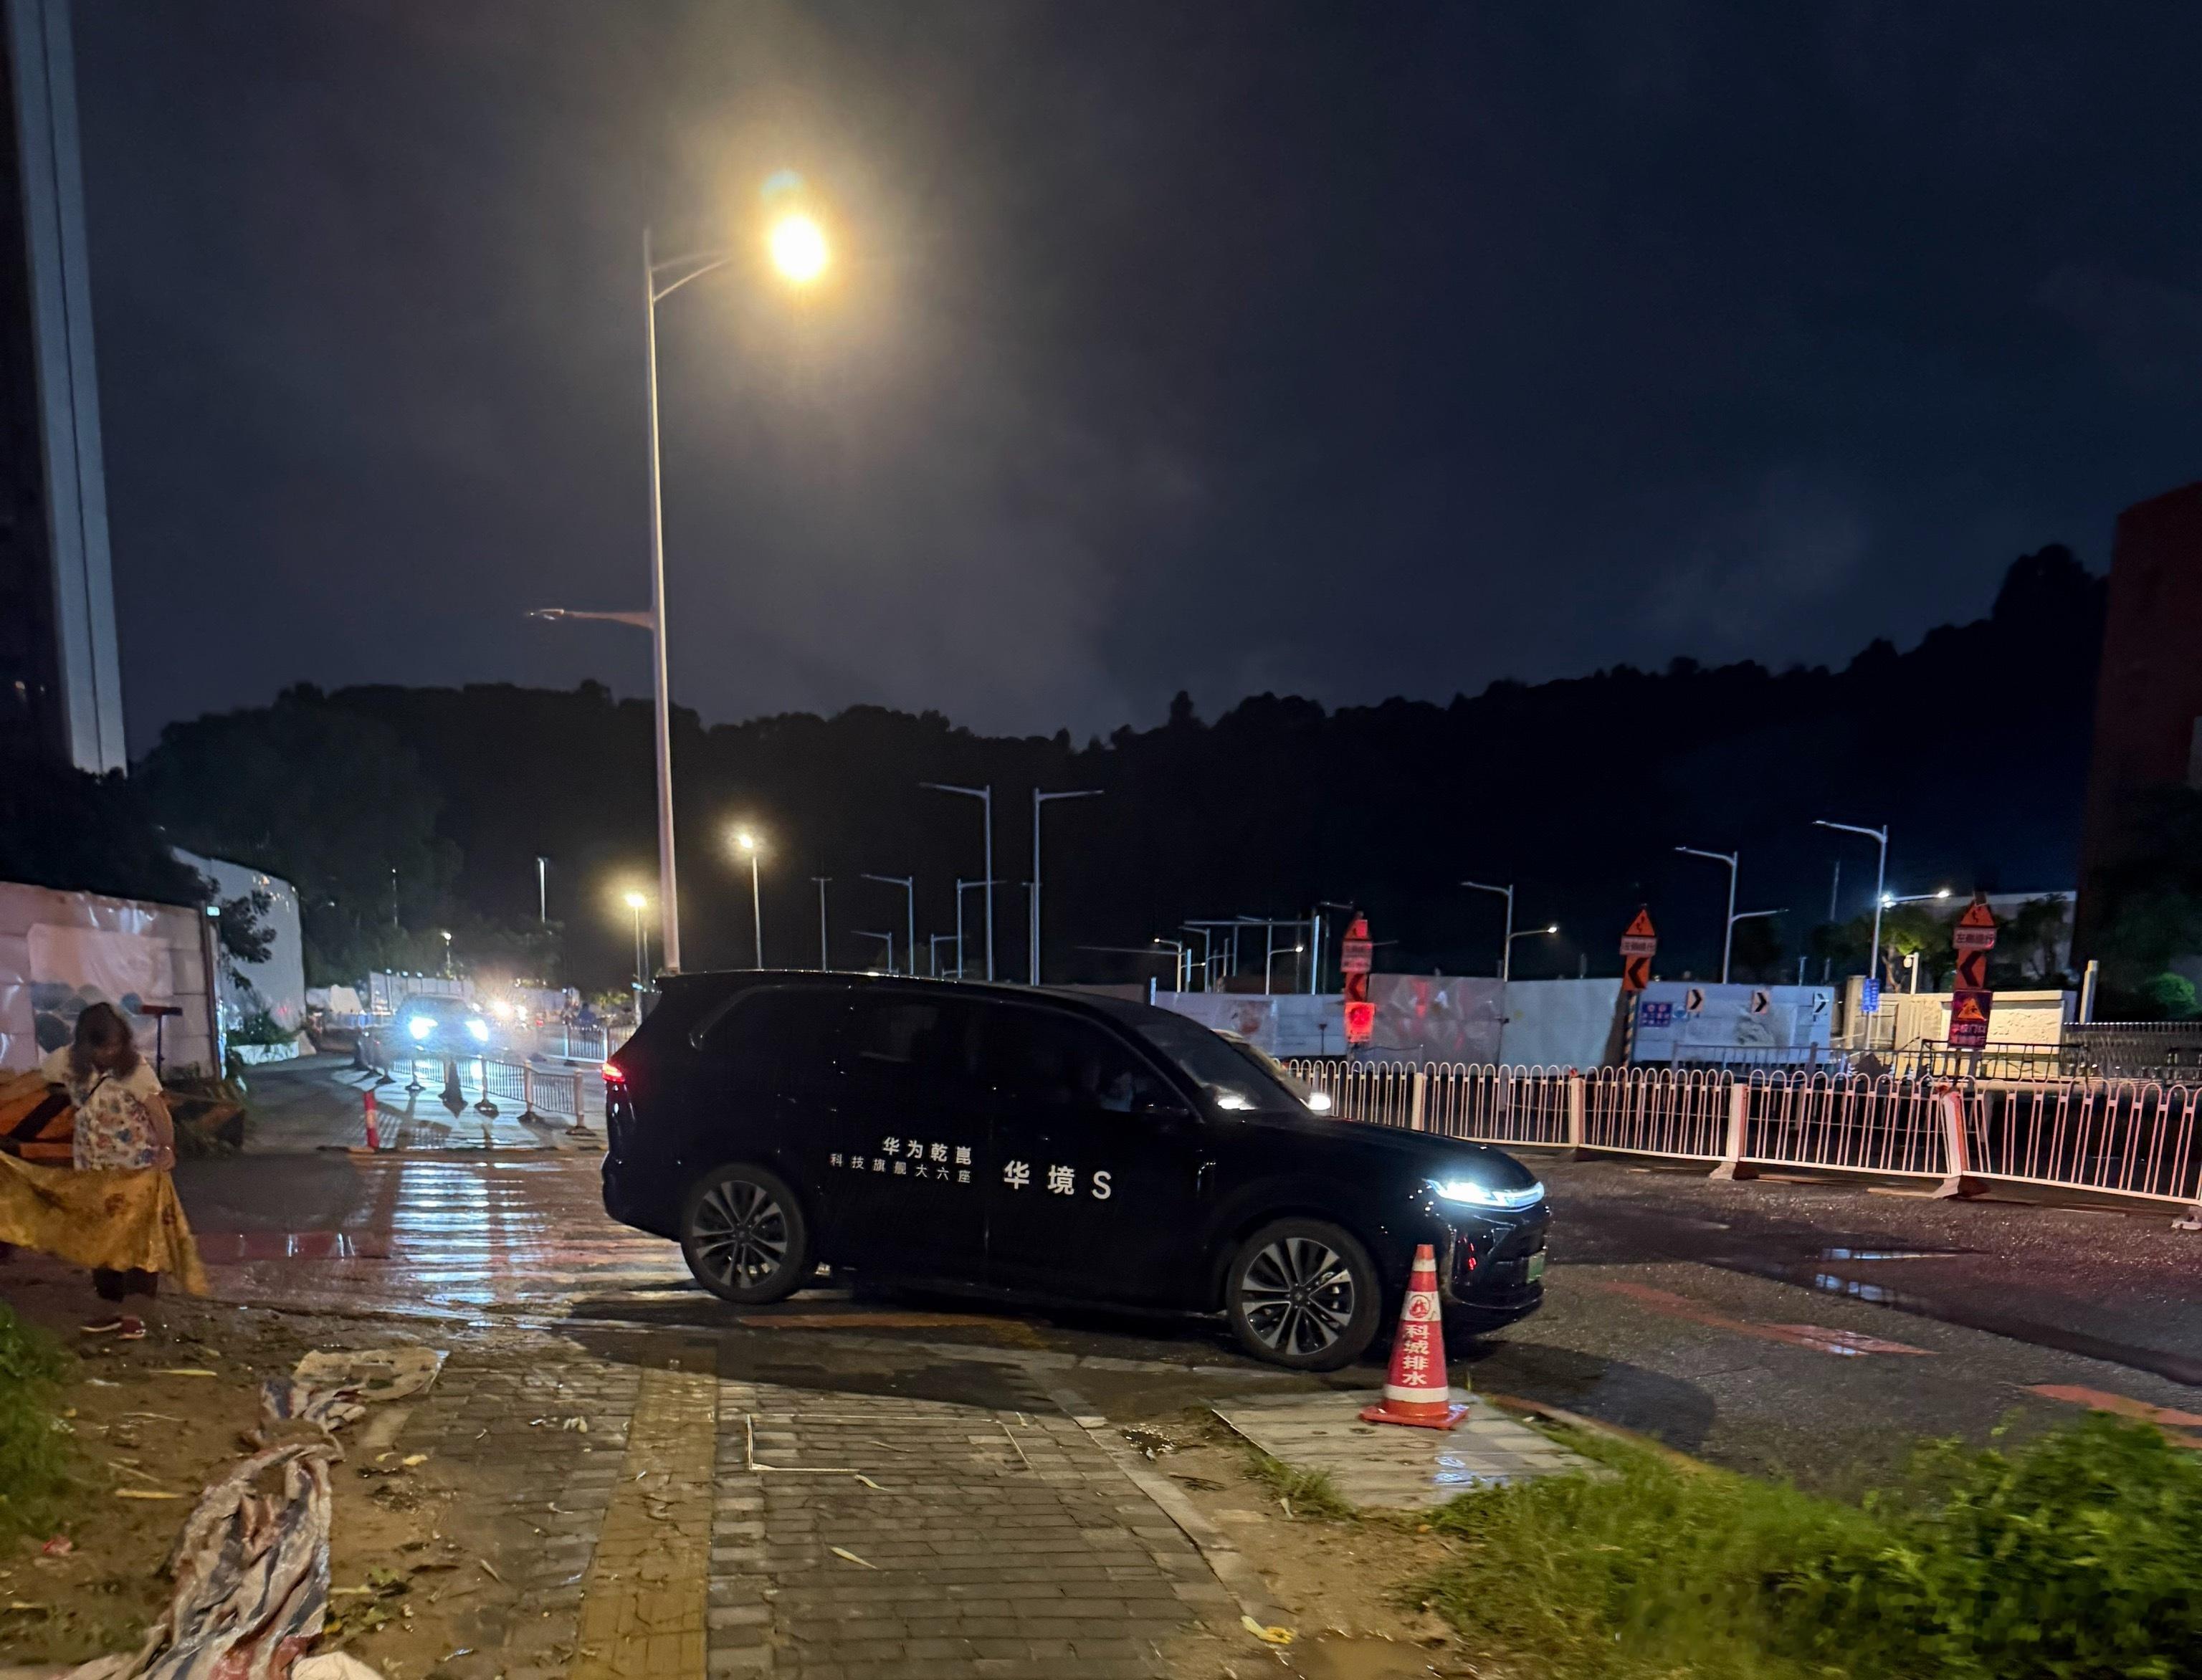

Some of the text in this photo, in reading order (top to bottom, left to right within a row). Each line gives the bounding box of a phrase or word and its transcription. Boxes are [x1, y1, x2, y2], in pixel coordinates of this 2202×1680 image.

[830, 1153, 971, 1183] 科技旗舰大六座
[882, 1137, 971, 1165] 华为乾崑
[1004, 1160, 1112, 1200] 华境S
[1402, 1324, 1431, 1386] 科城排水
